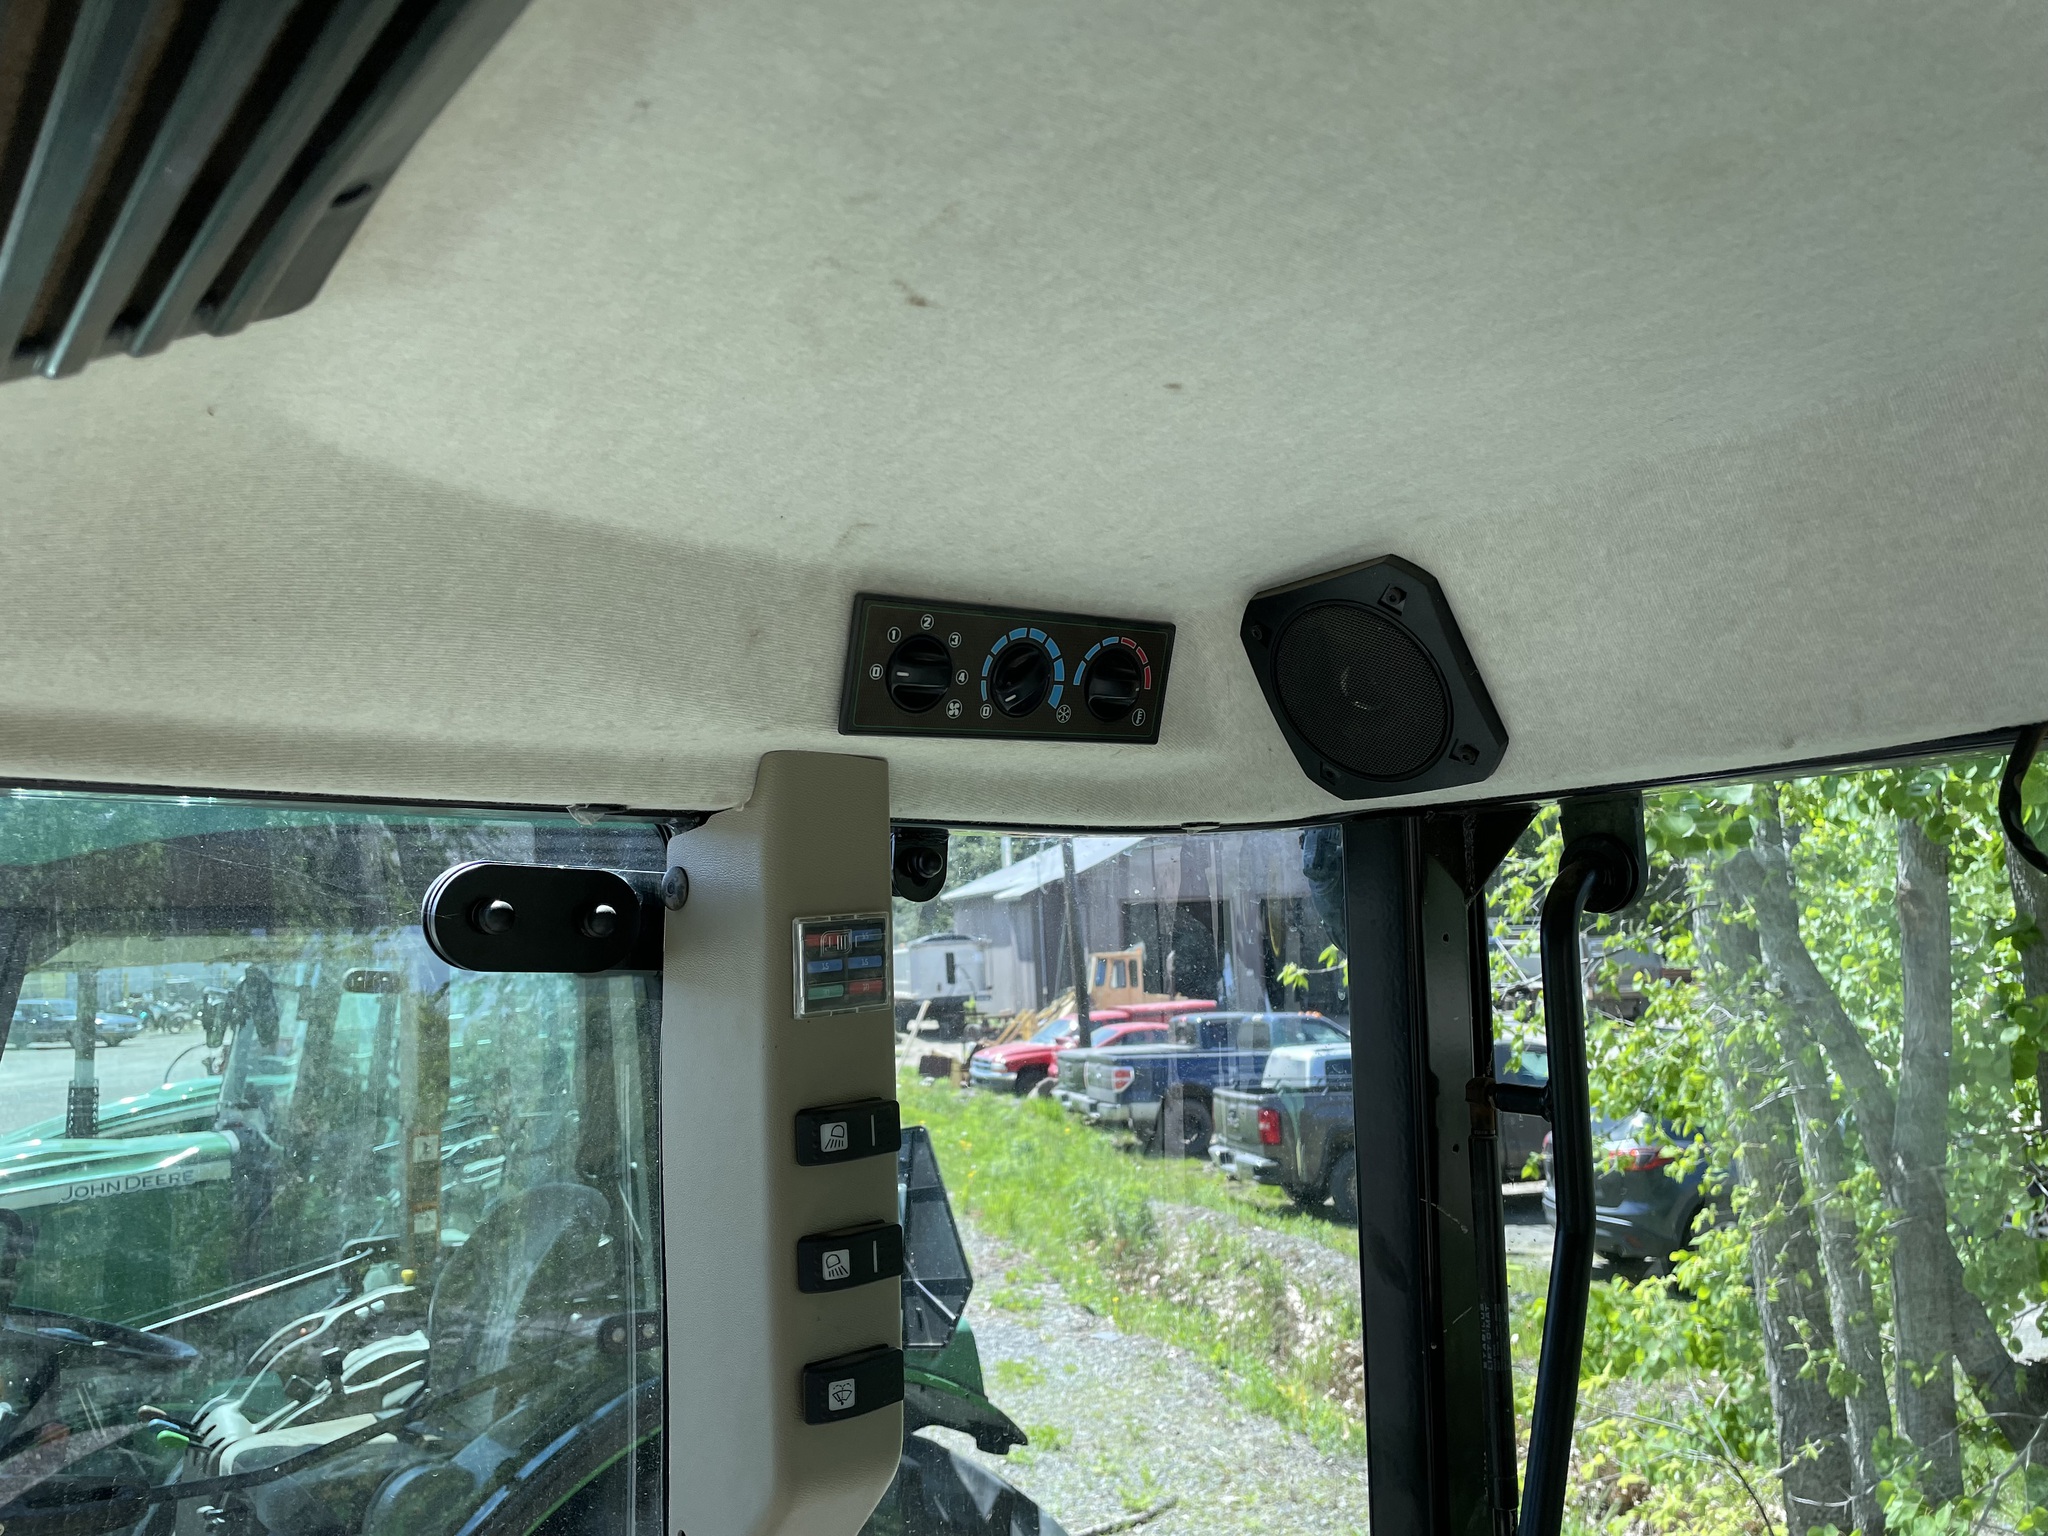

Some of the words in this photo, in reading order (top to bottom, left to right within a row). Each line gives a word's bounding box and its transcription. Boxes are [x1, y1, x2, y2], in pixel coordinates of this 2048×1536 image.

[922, 616, 932, 628] 2
[950, 634, 960, 646] 3
[871, 665, 881, 678] 0
[957, 672, 966, 683] 4
[982, 706, 991, 717] 0
[861, 958, 869, 966] 15
[61, 1180, 120, 1201] JOHN
[125, 1170, 194, 1190] DEERE
